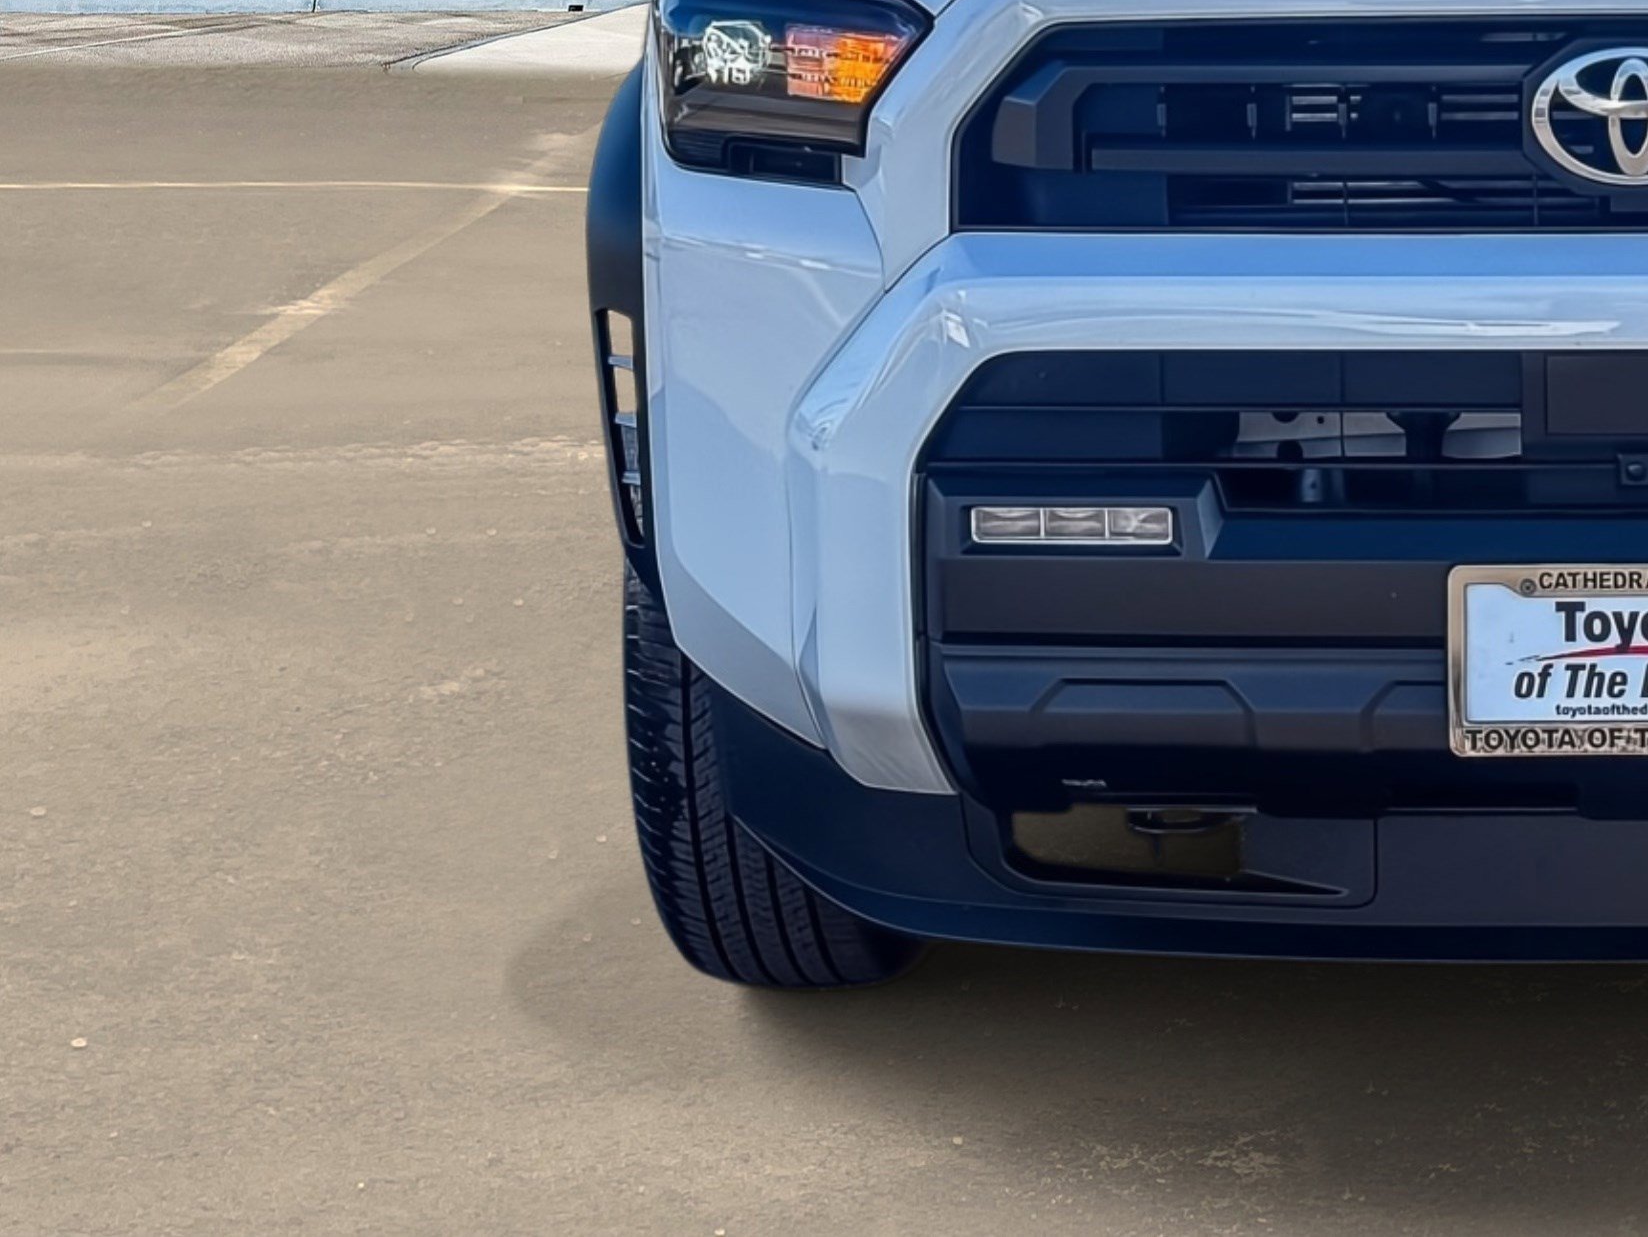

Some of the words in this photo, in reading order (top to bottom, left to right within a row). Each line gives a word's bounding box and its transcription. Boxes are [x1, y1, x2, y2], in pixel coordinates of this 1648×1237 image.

[1514, 664, 1553, 699] of
[1564, 664, 1628, 698] The
[1466, 728, 1575, 751] TOYOTA
[1587, 727, 1628, 750] OF
